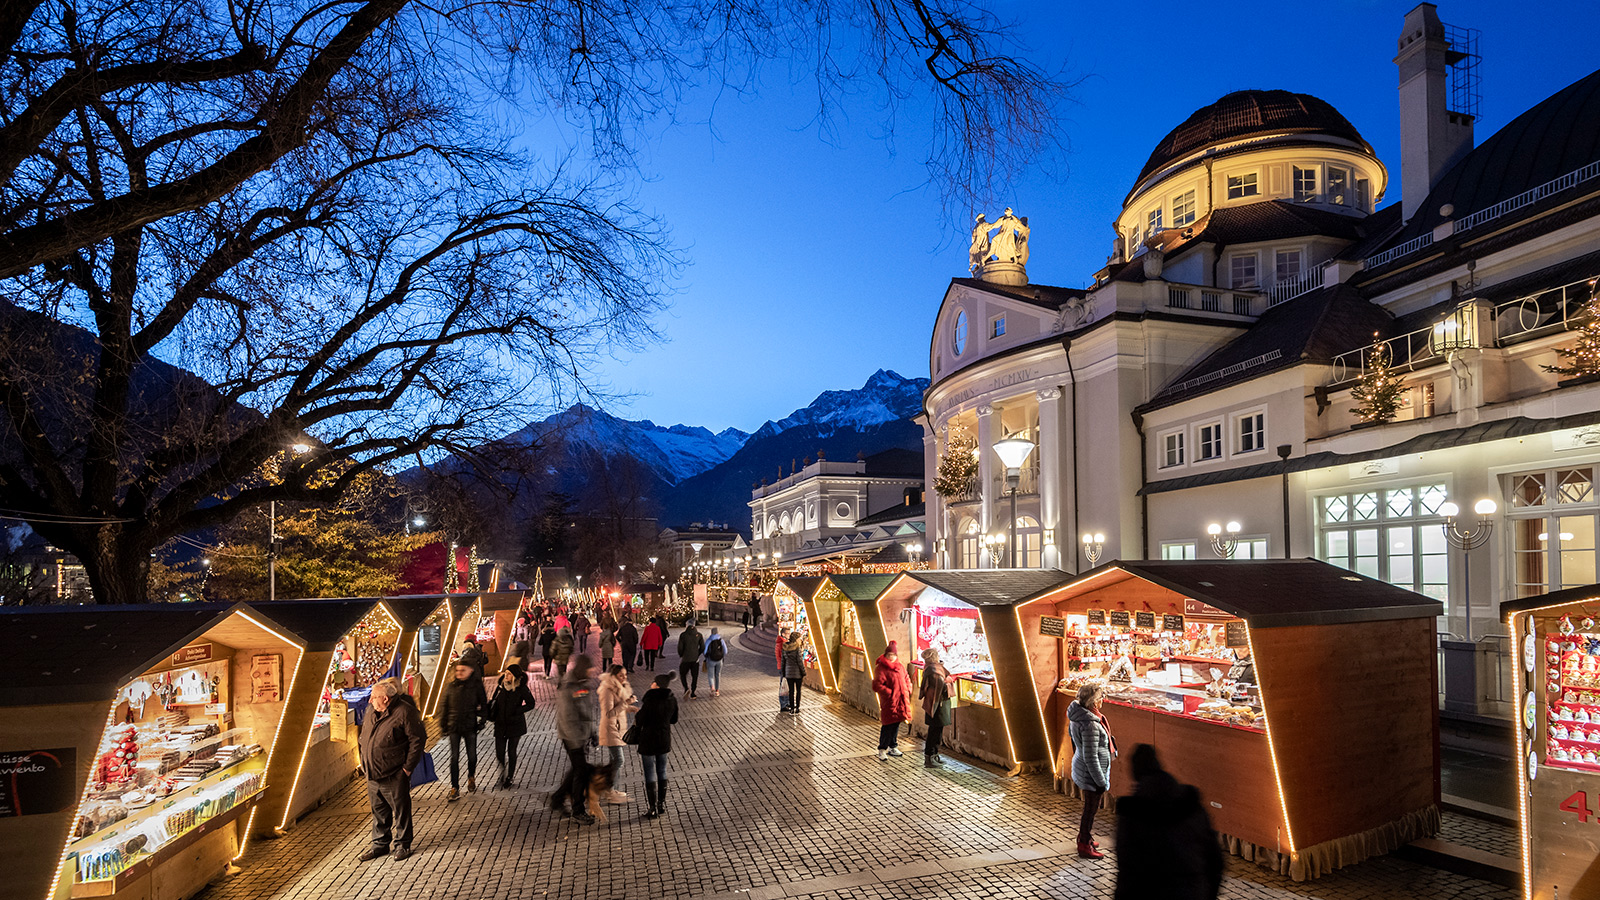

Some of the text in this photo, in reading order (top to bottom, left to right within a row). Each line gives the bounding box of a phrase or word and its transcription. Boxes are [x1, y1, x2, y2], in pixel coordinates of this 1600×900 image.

[174, 653, 180, 661] 43
[0, 763, 46, 775] vvento
[1559, 790, 1600, 824] 4
